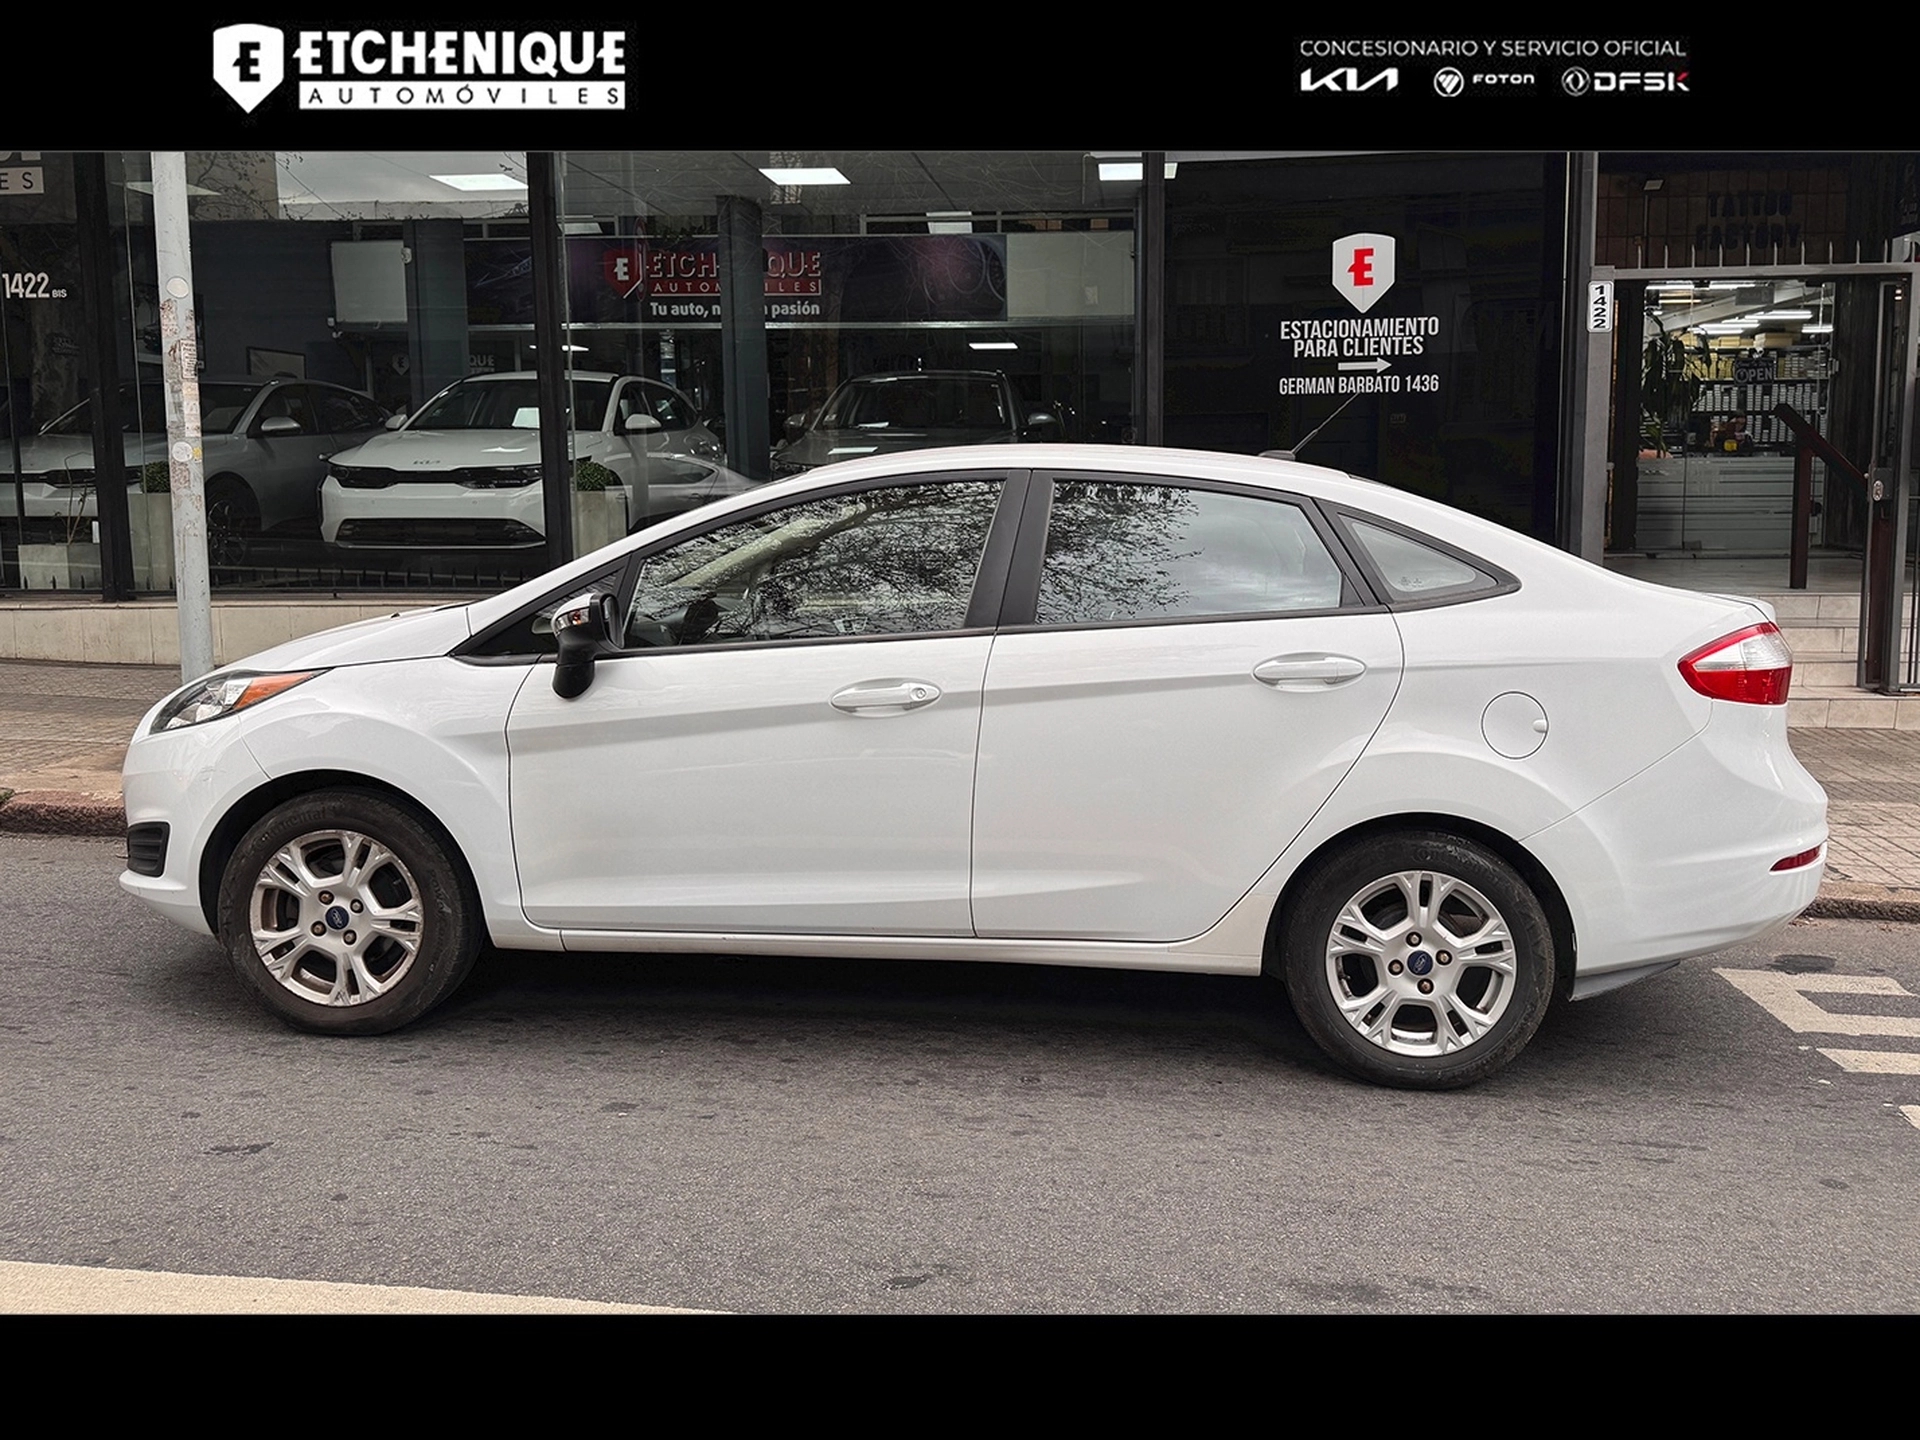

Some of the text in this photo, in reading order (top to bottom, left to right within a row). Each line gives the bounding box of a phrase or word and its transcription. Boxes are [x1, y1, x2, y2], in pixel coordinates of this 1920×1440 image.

[2, 272, 67, 299] 1422 BIS
[650, 302, 668, 316] Tu
[670, 302, 709, 318] auto,
[771, 300, 820, 318] pasión
[1593, 284, 1607, 329] 1422
[1280, 316, 1440, 340] ESTACIONAMIENTO
[1293, 335, 1424, 358] PARA CLIENTES
[1279, 374, 1440, 395] GERMAN BARBATO 1436
[1735, 367, 1773, 384] OPEN
